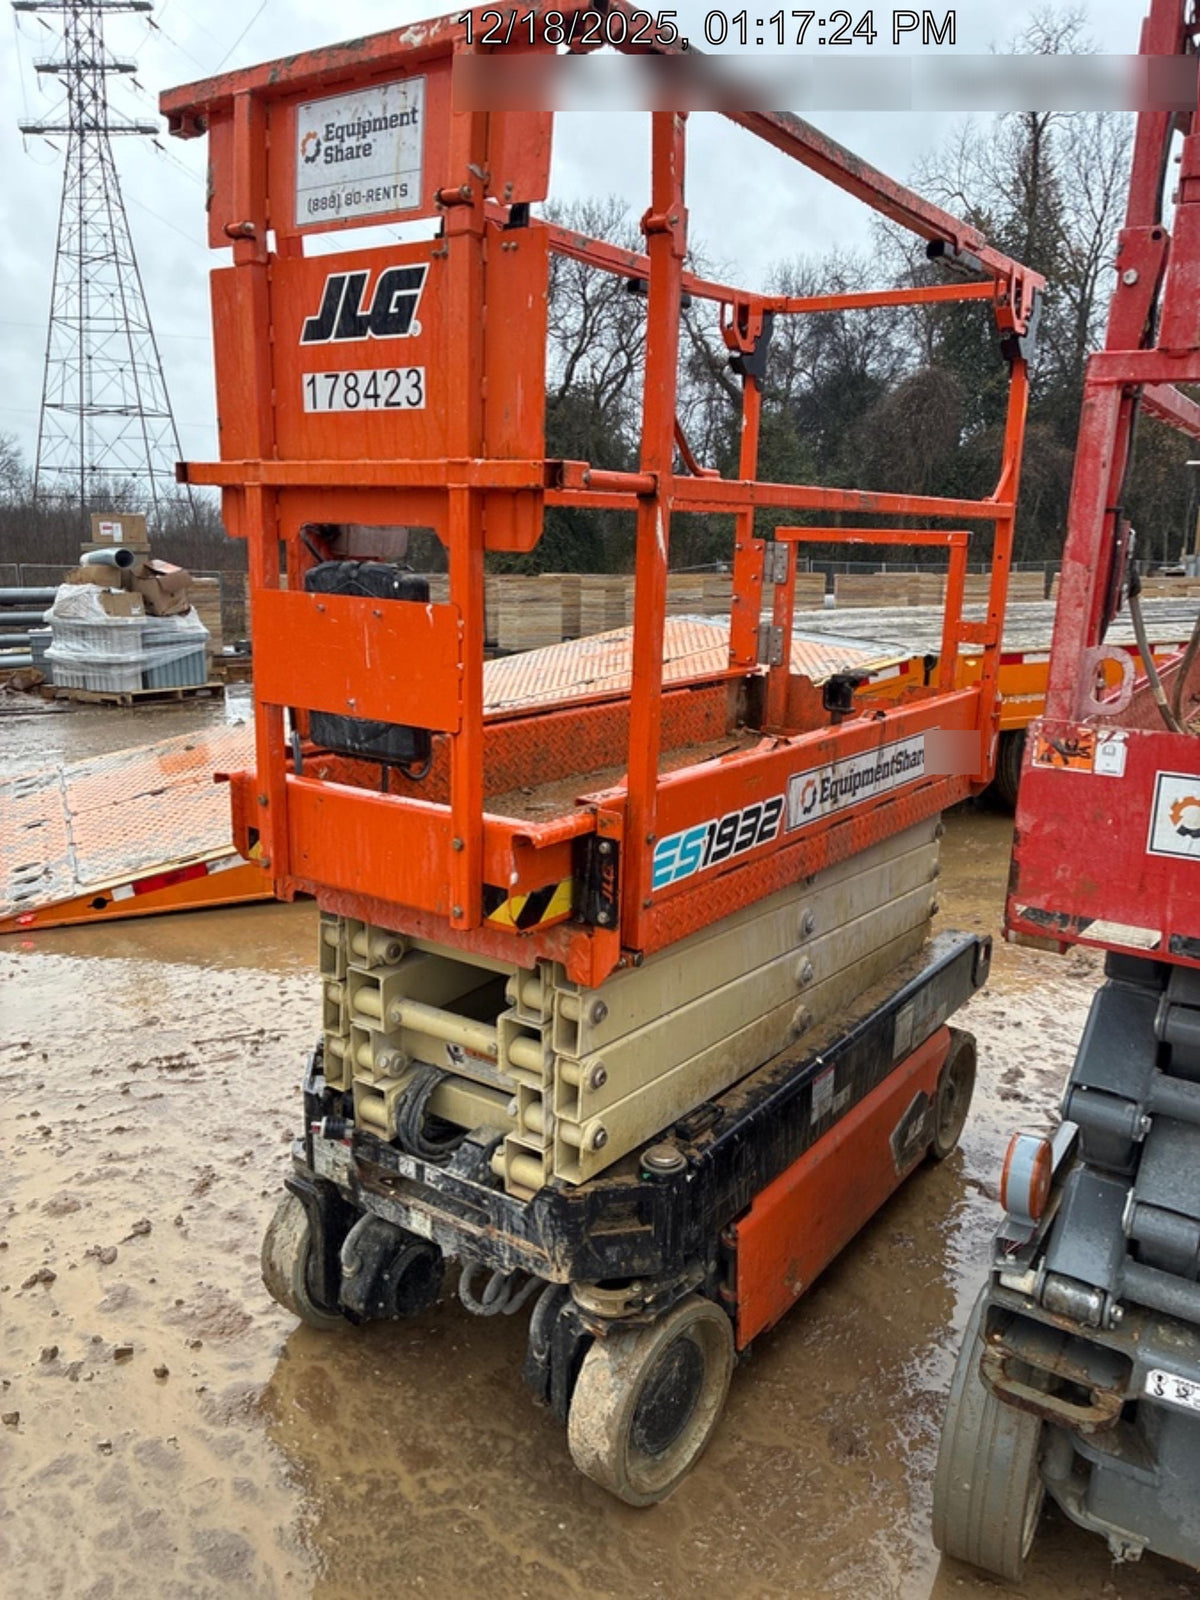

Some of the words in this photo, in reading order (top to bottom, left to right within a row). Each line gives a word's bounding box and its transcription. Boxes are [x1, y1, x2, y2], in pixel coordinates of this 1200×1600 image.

[324, 106, 418, 143] Equipment
[323, 142, 373, 164] Share
[307, 193, 341, 215] (888)
[344, 183, 408, 206] 80-RENTS
[301, 264, 428, 343] JLG
[306, 368, 423, 410] 178423
[819, 748, 925, 804] EquipmentShar
[652, 797, 784, 889] ES1932
